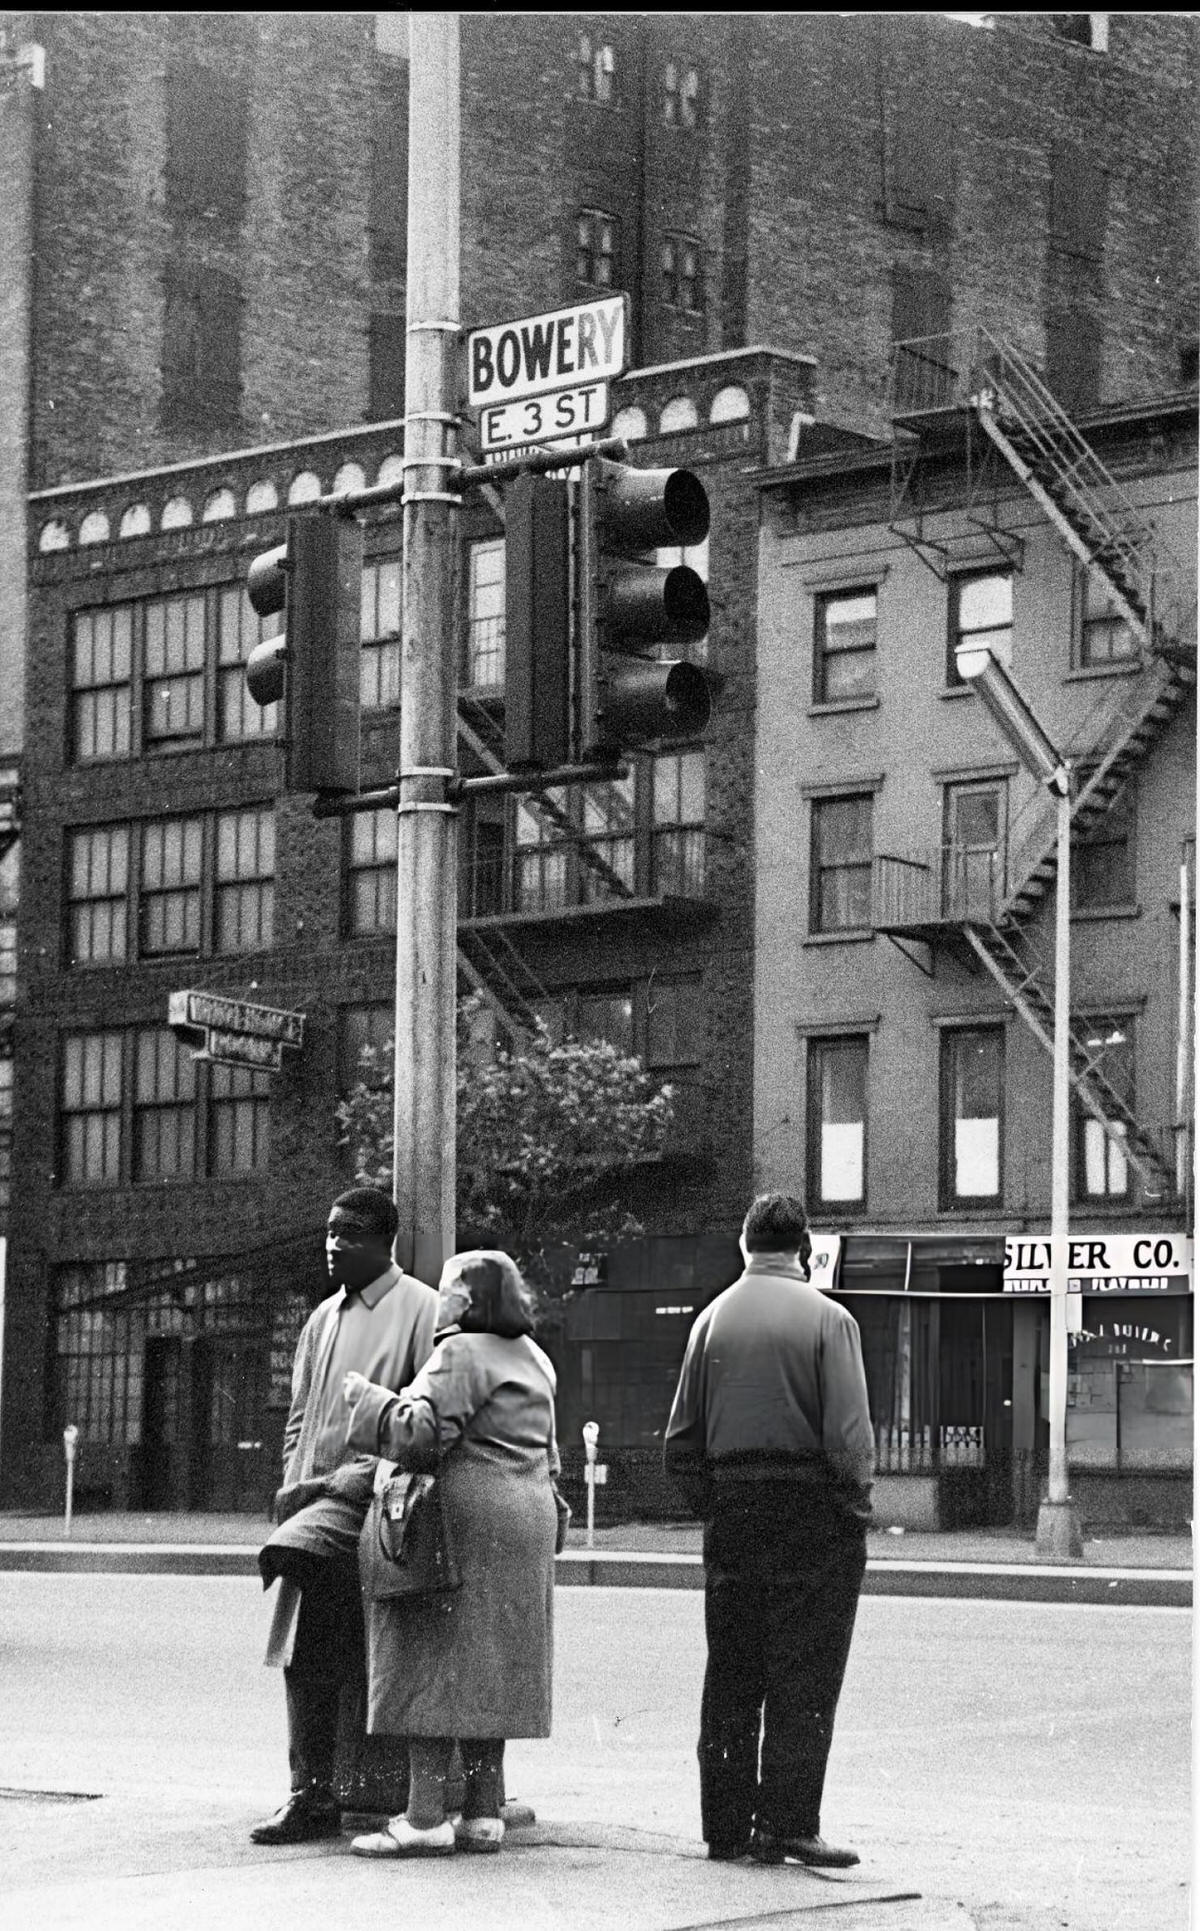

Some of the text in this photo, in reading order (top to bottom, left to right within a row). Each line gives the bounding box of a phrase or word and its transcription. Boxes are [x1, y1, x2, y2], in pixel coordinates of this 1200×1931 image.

[473, 306, 622, 393] BOWERY
[487, 388, 597, 443] E. 3 ST
[1004, 1240, 1180, 1270] SILER CO.
